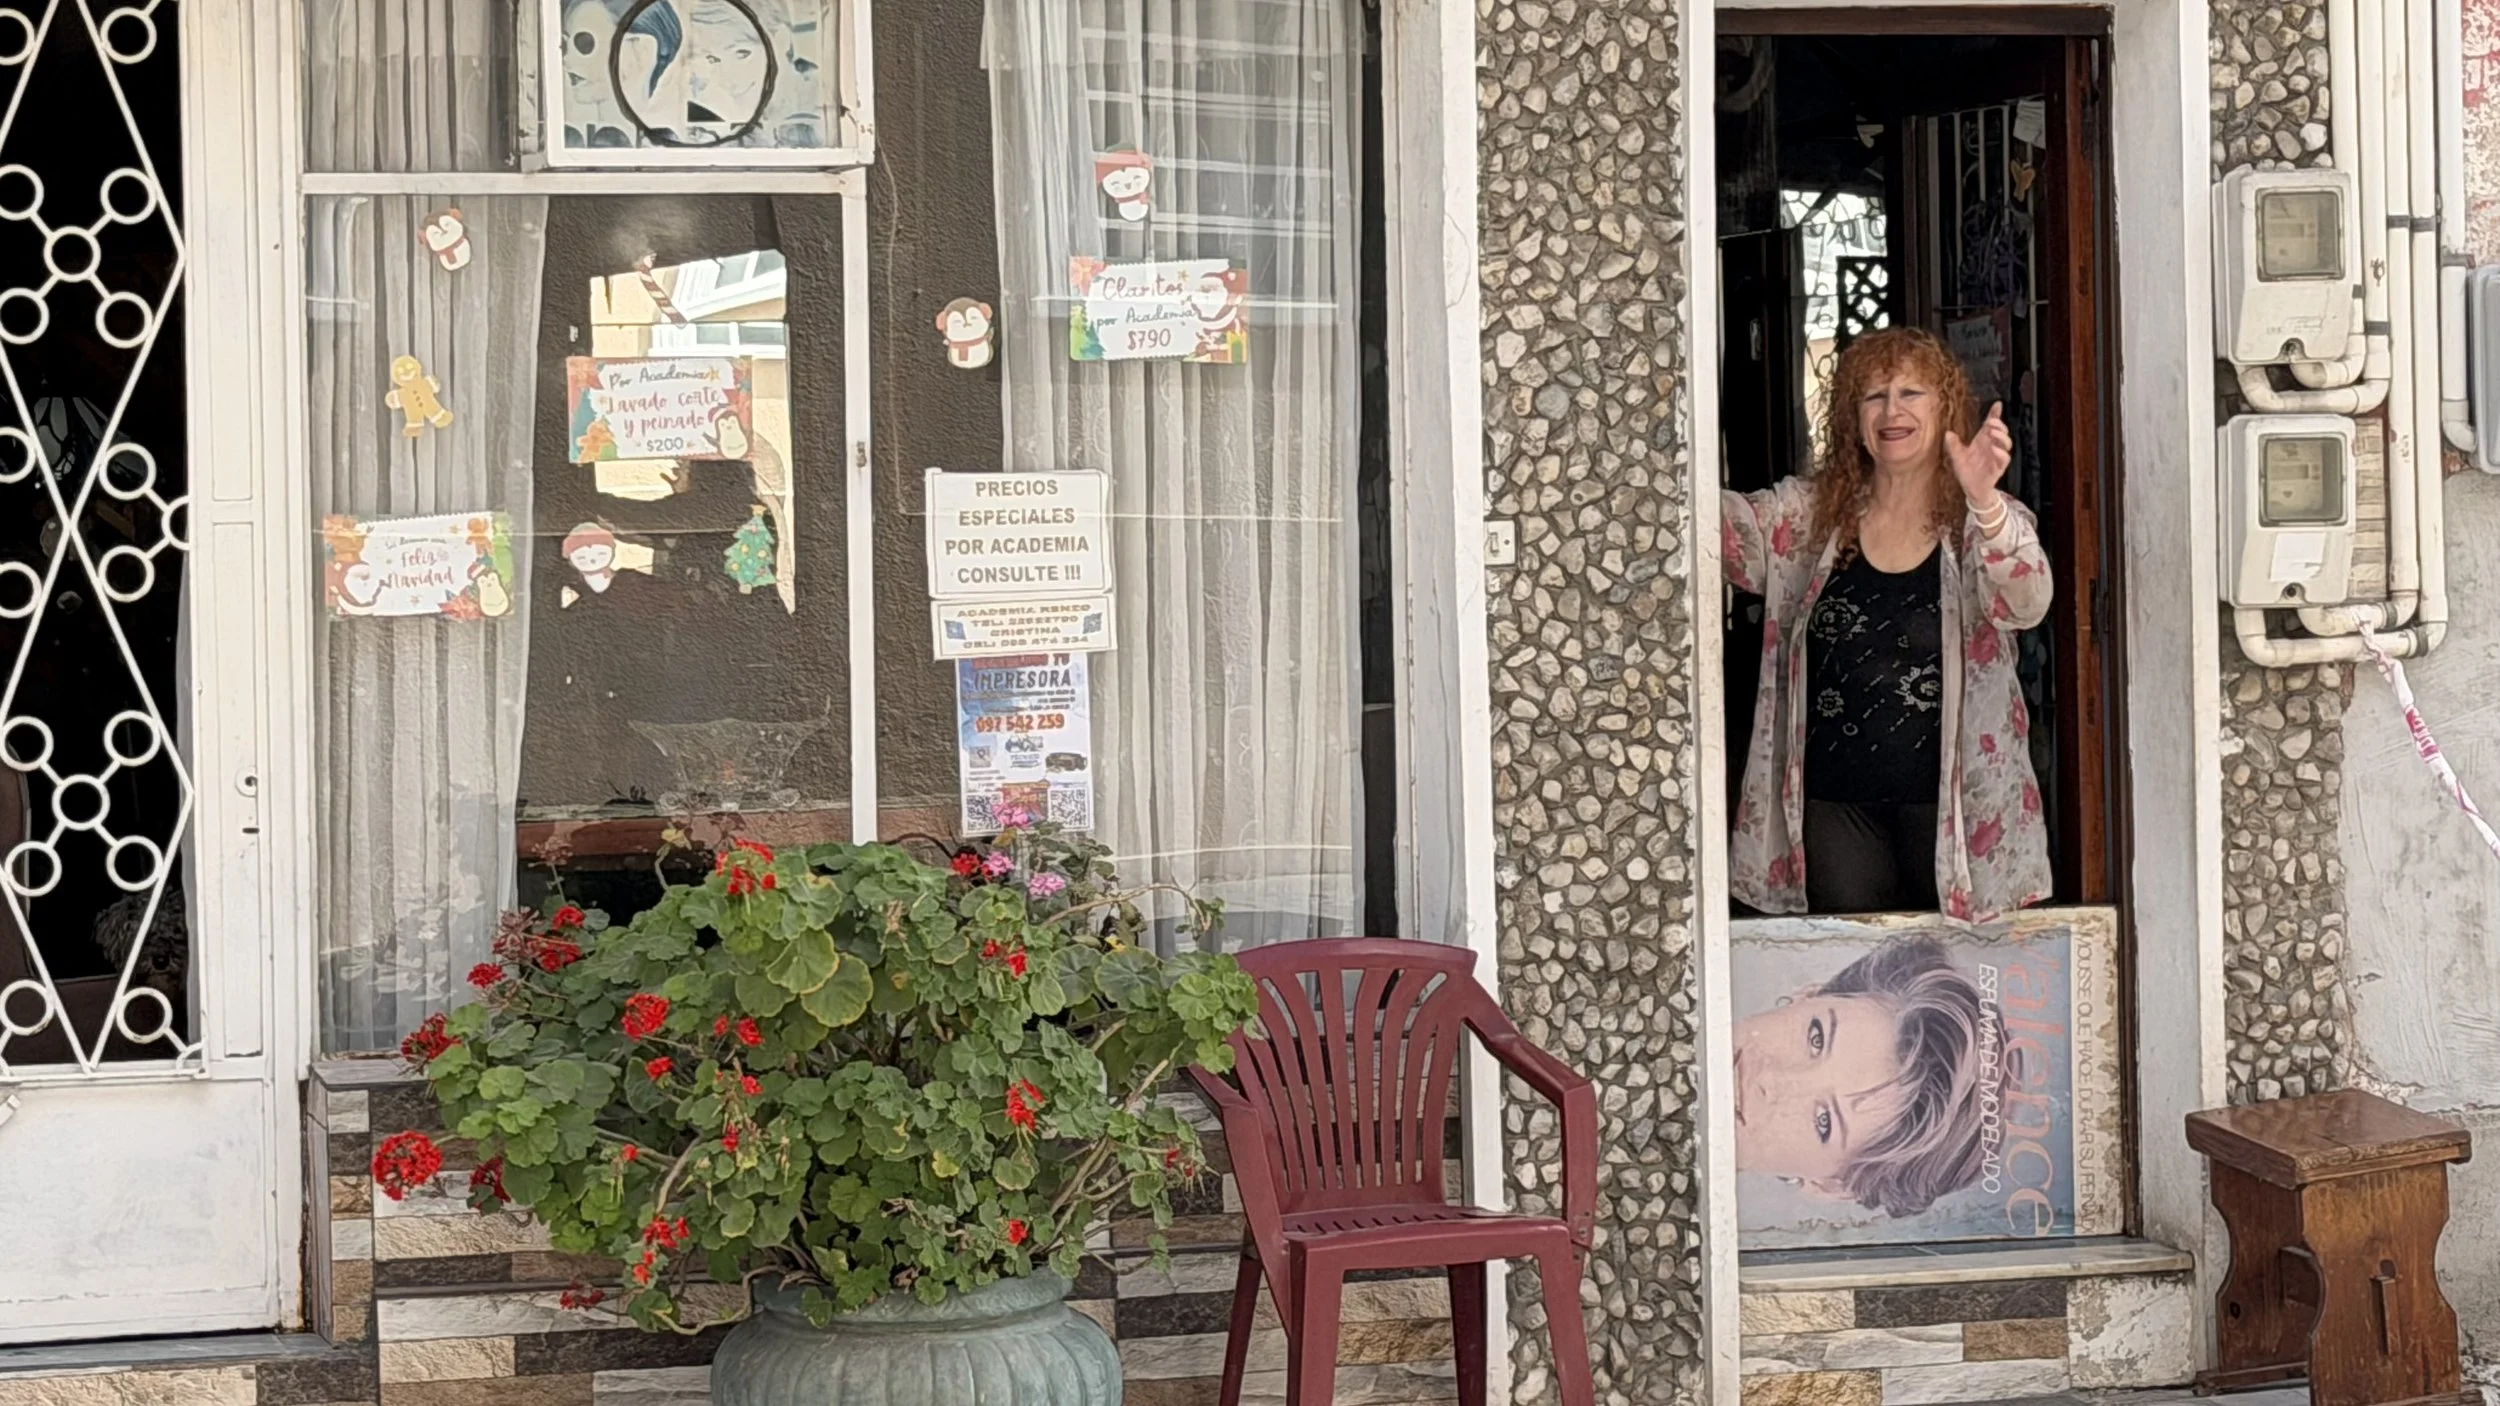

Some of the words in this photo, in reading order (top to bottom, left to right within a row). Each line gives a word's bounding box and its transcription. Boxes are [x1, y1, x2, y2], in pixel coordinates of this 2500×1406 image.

[1102, 273, 1183, 300] Claritos
[1127, 328, 1172, 351] $790
[609, 373, 633, 390] Por
[639, 364, 708, 384] Academia
[623, 419, 634, 438] y
[641, 410, 705, 437] peinado
[646, 437, 684, 452] $200
[975, 479, 1059, 497] PRECIOS
[958, 507, 1075, 526] ESPECIALES
[945, 539, 985, 556] POR
[990, 536, 1090, 554] ACADEMIA
[957, 565, 1059, 583] CONSULTE
[1064, 564, 1081, 581] !!!
[957, 606, 1037, 618] ACADEMIA
[1040, 604, 1091, 614] RENZO
[990, 627, 1061, 638] CRISTINA
[974, 669, 1072, 690] IMPRESORA
[1978, 963, 1998, 1045] ESPUMA
[2077, 1002, 2093, 1037] QUE
[1979, 1046, 1999, 1079] DE
[2077, 1040, 2093, 1084] HACE
[2078, 1088, 2095, 1144] DURAR
[1980, 1080, 2002, 1194] MODELADO
[2079, 1147, 2095, 1170] SU
